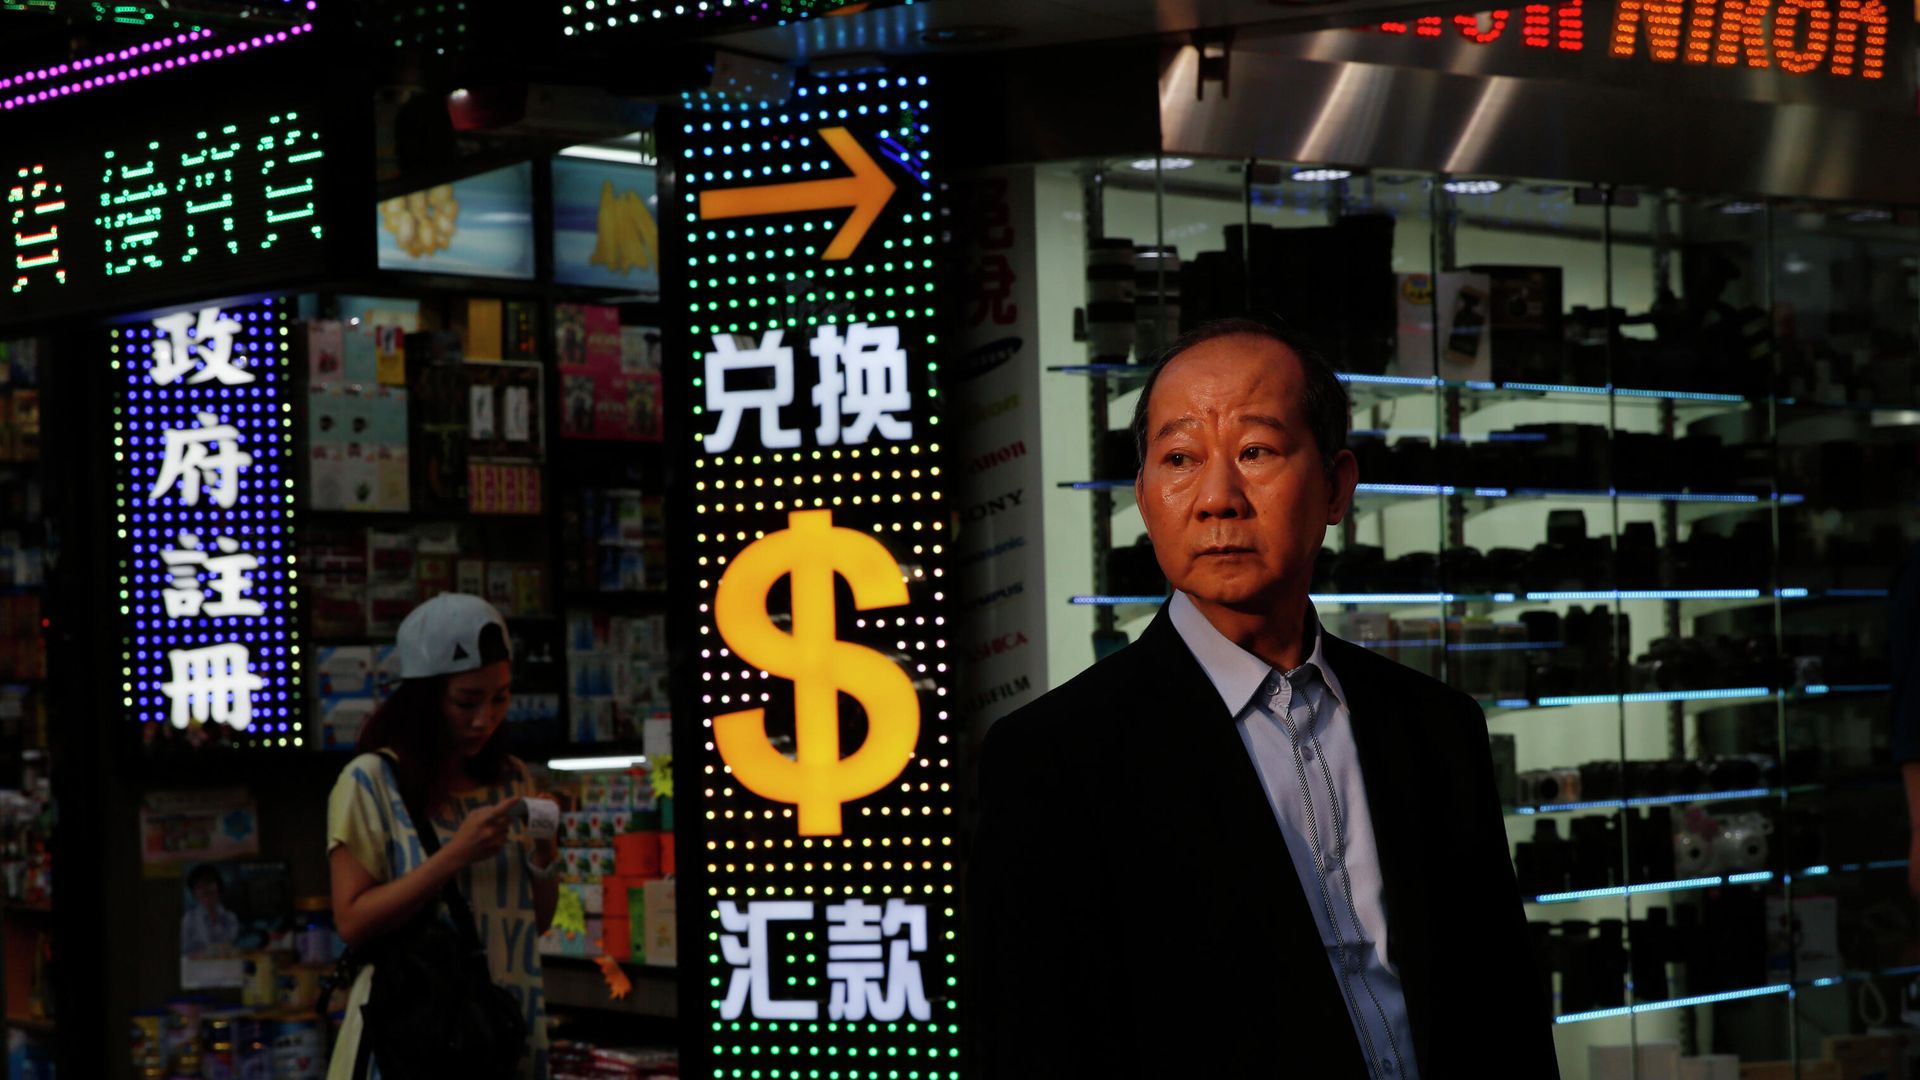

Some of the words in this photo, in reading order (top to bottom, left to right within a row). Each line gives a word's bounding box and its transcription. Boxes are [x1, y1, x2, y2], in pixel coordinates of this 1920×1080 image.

[147, 306, 266, 732] 政府註冊
[716, 897, 932, 1023] 汇款
